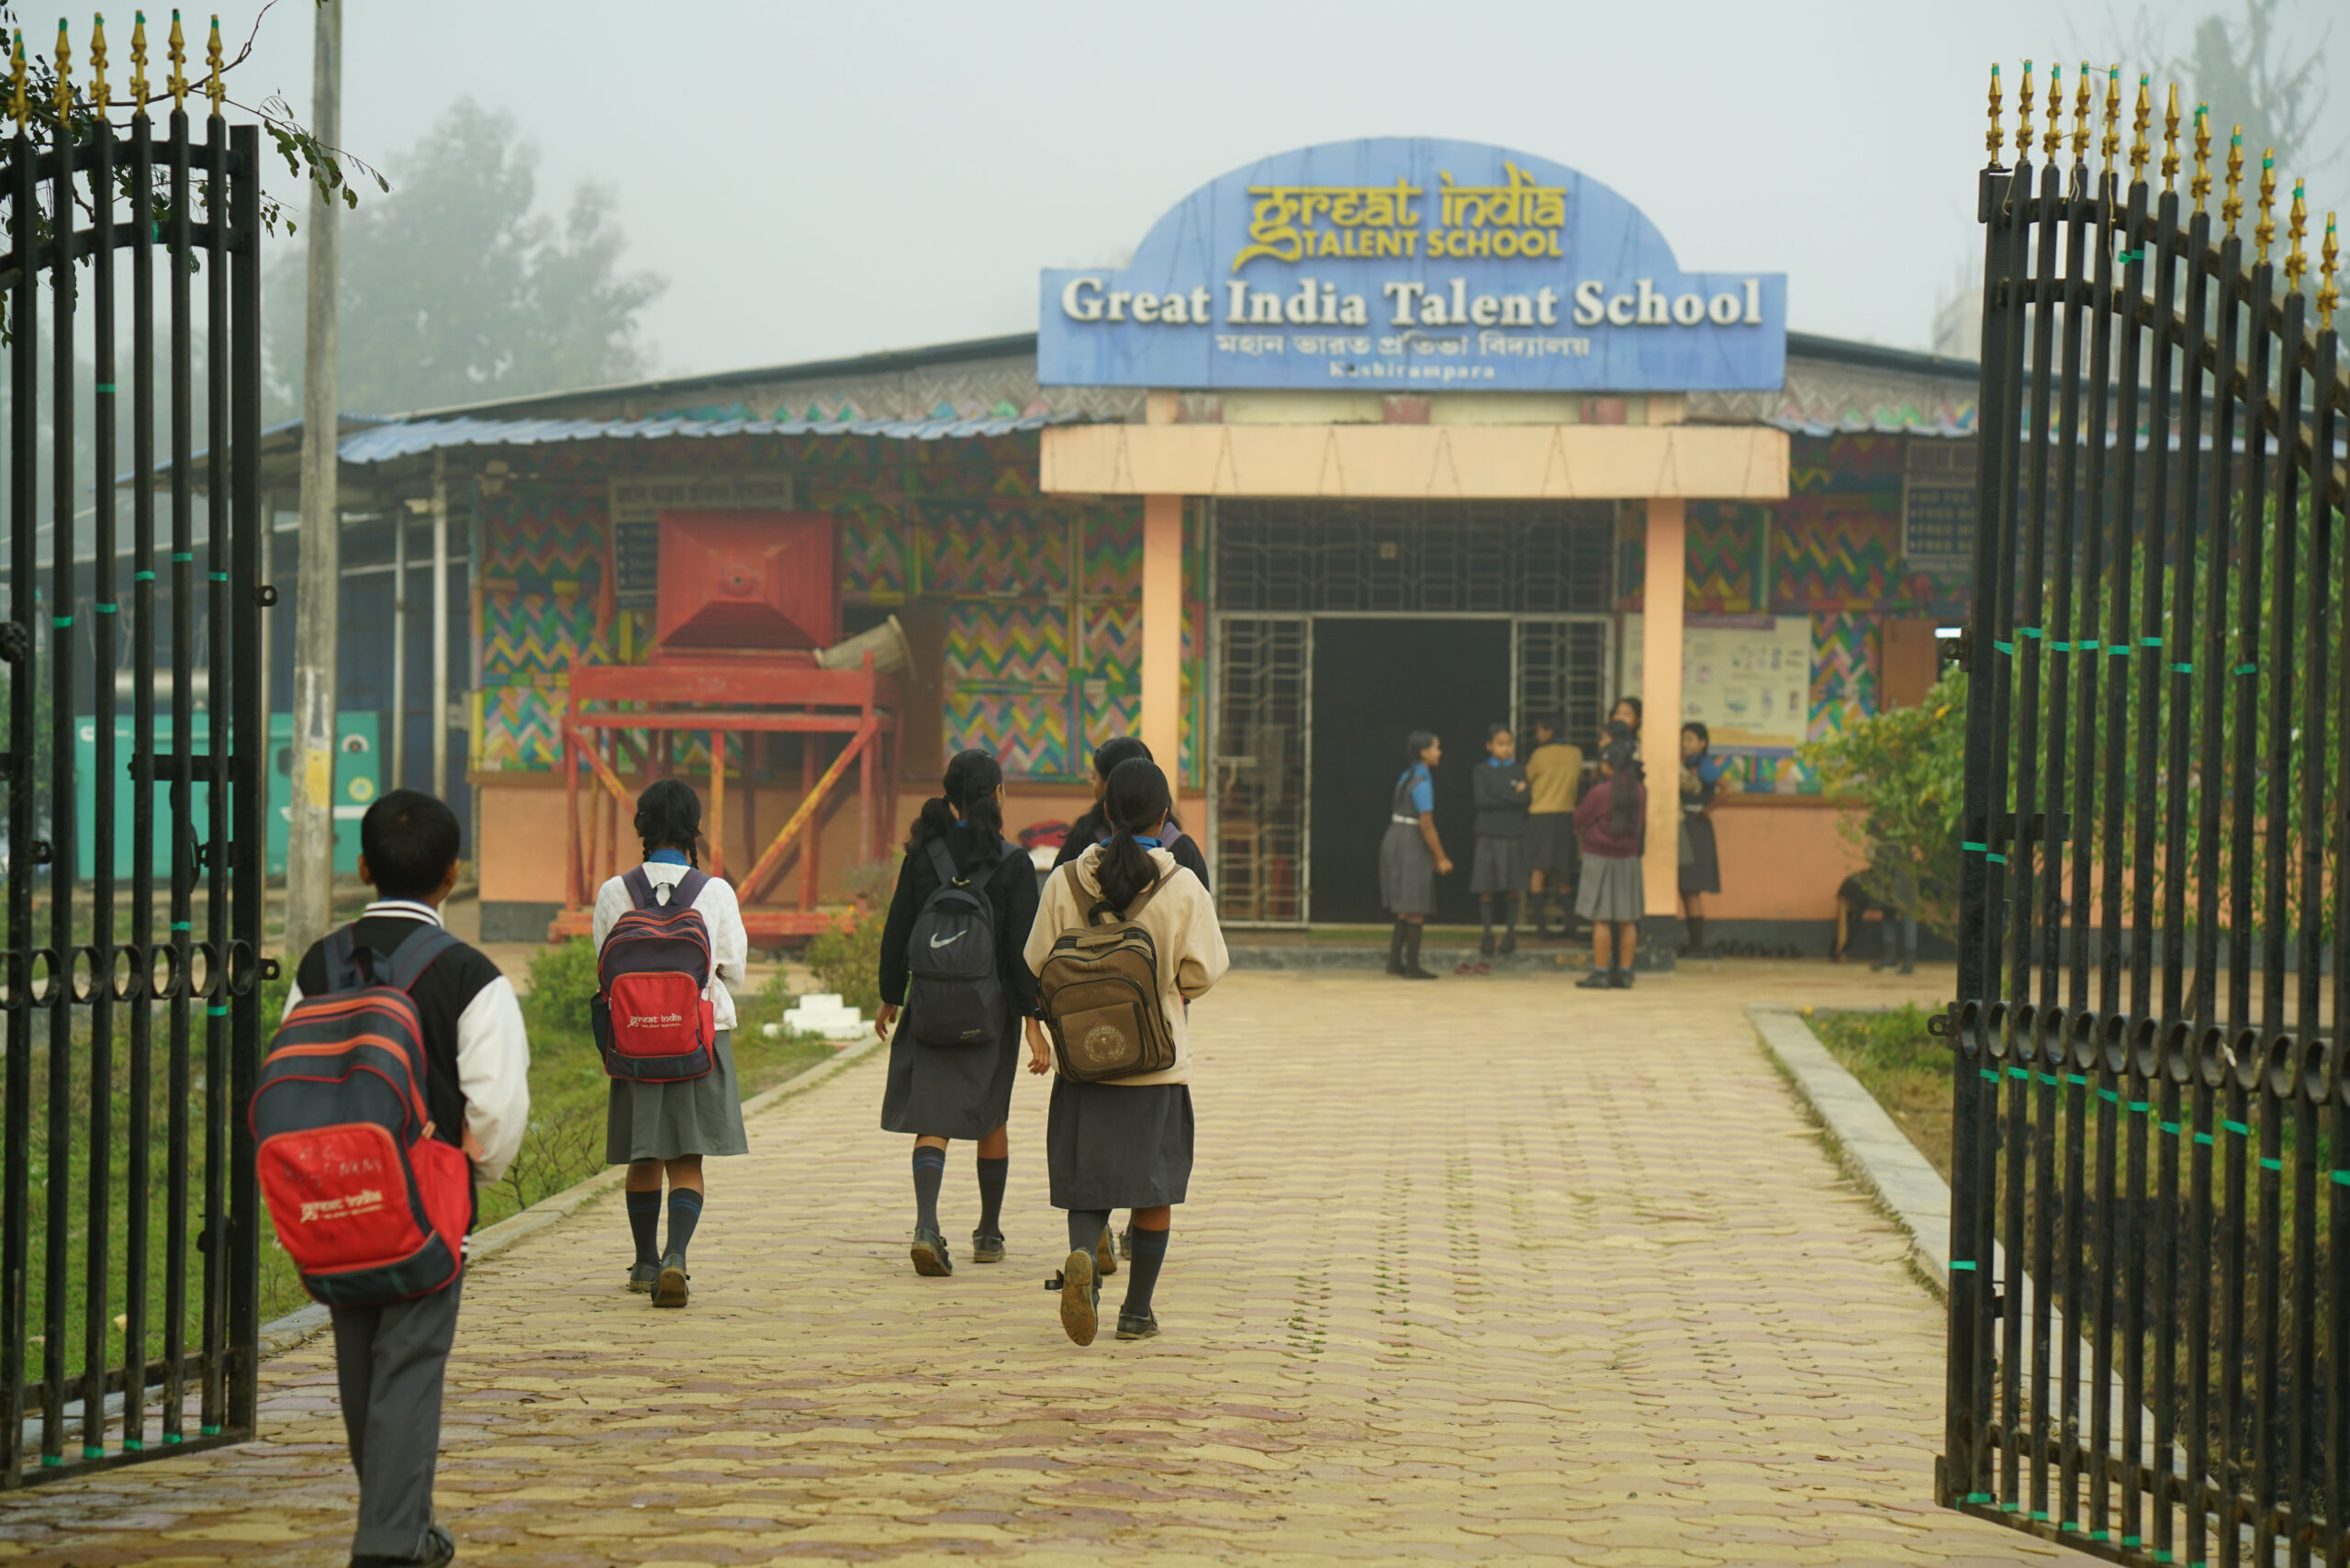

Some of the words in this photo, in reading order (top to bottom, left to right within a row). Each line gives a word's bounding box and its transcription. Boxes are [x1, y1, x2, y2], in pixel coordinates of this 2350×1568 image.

[1232, 176, 1423, 274] great
[1439, 161, 1568, 229] india
[1302, 230, 1419, 257] TALENT
[1426, 230, 1563, 258] SCHOOL
[1061, 276, 1212, 324] Great
[1225, 277, 1369, 326] India
[1383, 277, 1559, 327] Talent
[1572, 277, 1762, 327] School
